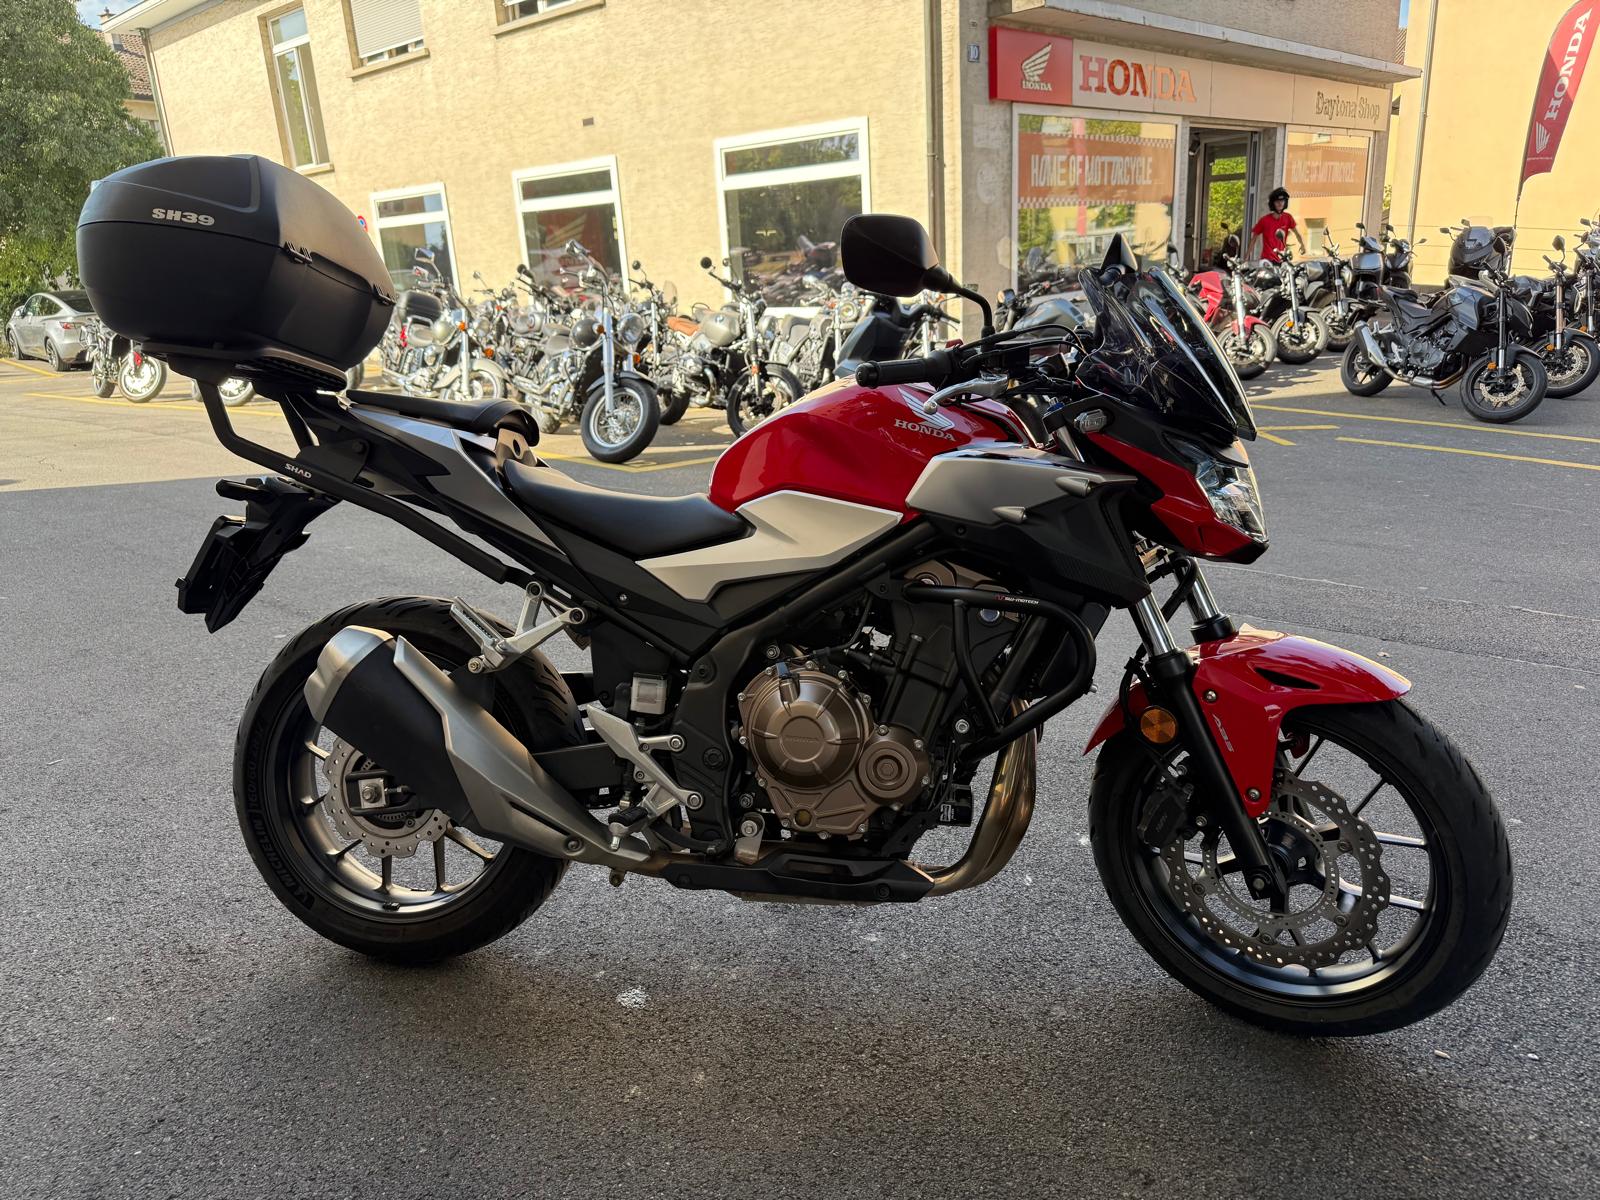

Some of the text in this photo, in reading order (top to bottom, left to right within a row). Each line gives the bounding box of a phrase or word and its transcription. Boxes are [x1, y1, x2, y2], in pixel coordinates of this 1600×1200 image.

[1079, 54, 1197, 103] HONDA
[1544, 8, 1592, 121] HONDA
[1022, 79, 1053, 92] HONDA
[1315, 90, 1380, 125] Daytona Shop
[1030, 154, 1067, 187] HOME
[1068, 154, 1083, 187] OF
[151, 207, 215, 226] SH39
[893, 418, 957, 442] HONDA
[284, 463, 312, 479] SHAD
[1212, 712, 1235, 752] ABS
[252, 816, 298, 889] MICHELIN
